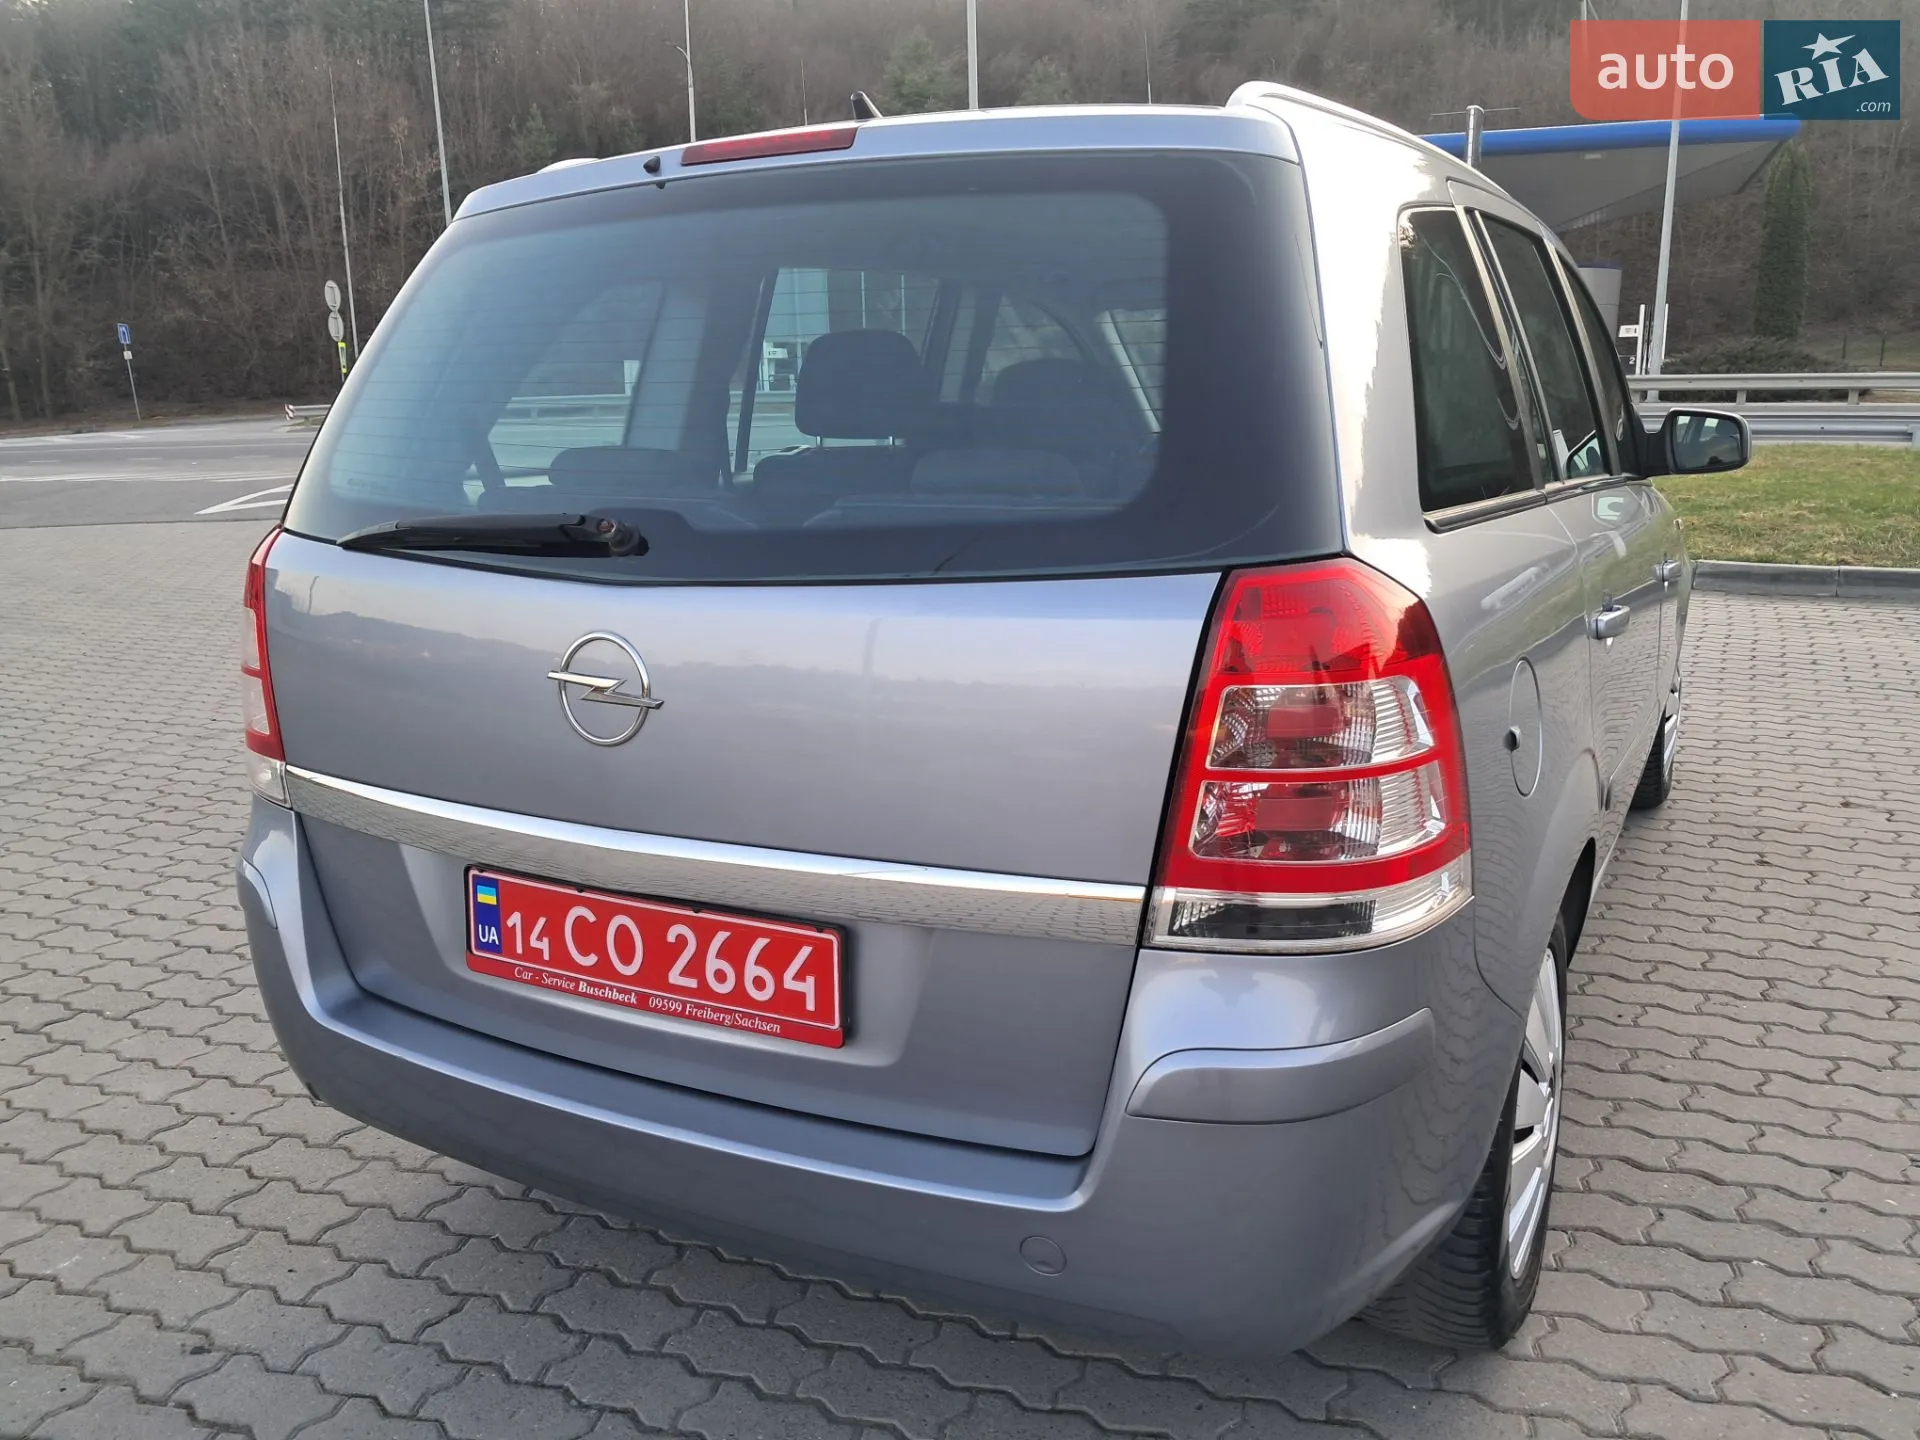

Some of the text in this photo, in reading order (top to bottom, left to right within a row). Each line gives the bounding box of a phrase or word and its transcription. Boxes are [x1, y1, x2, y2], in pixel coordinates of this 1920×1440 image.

[478, 923, 499, 945] UA
[506, 905, 816, 1012] 14 CO 2664
[514, 966, 533, 980] Car
[541, 972, 576, 990] Service
[578, 981, 638, 1005] Buschbeck
[649, 996, 682, 1013] 09599
[685, 1004, 781, 1034] Freiberg/Sachsen
